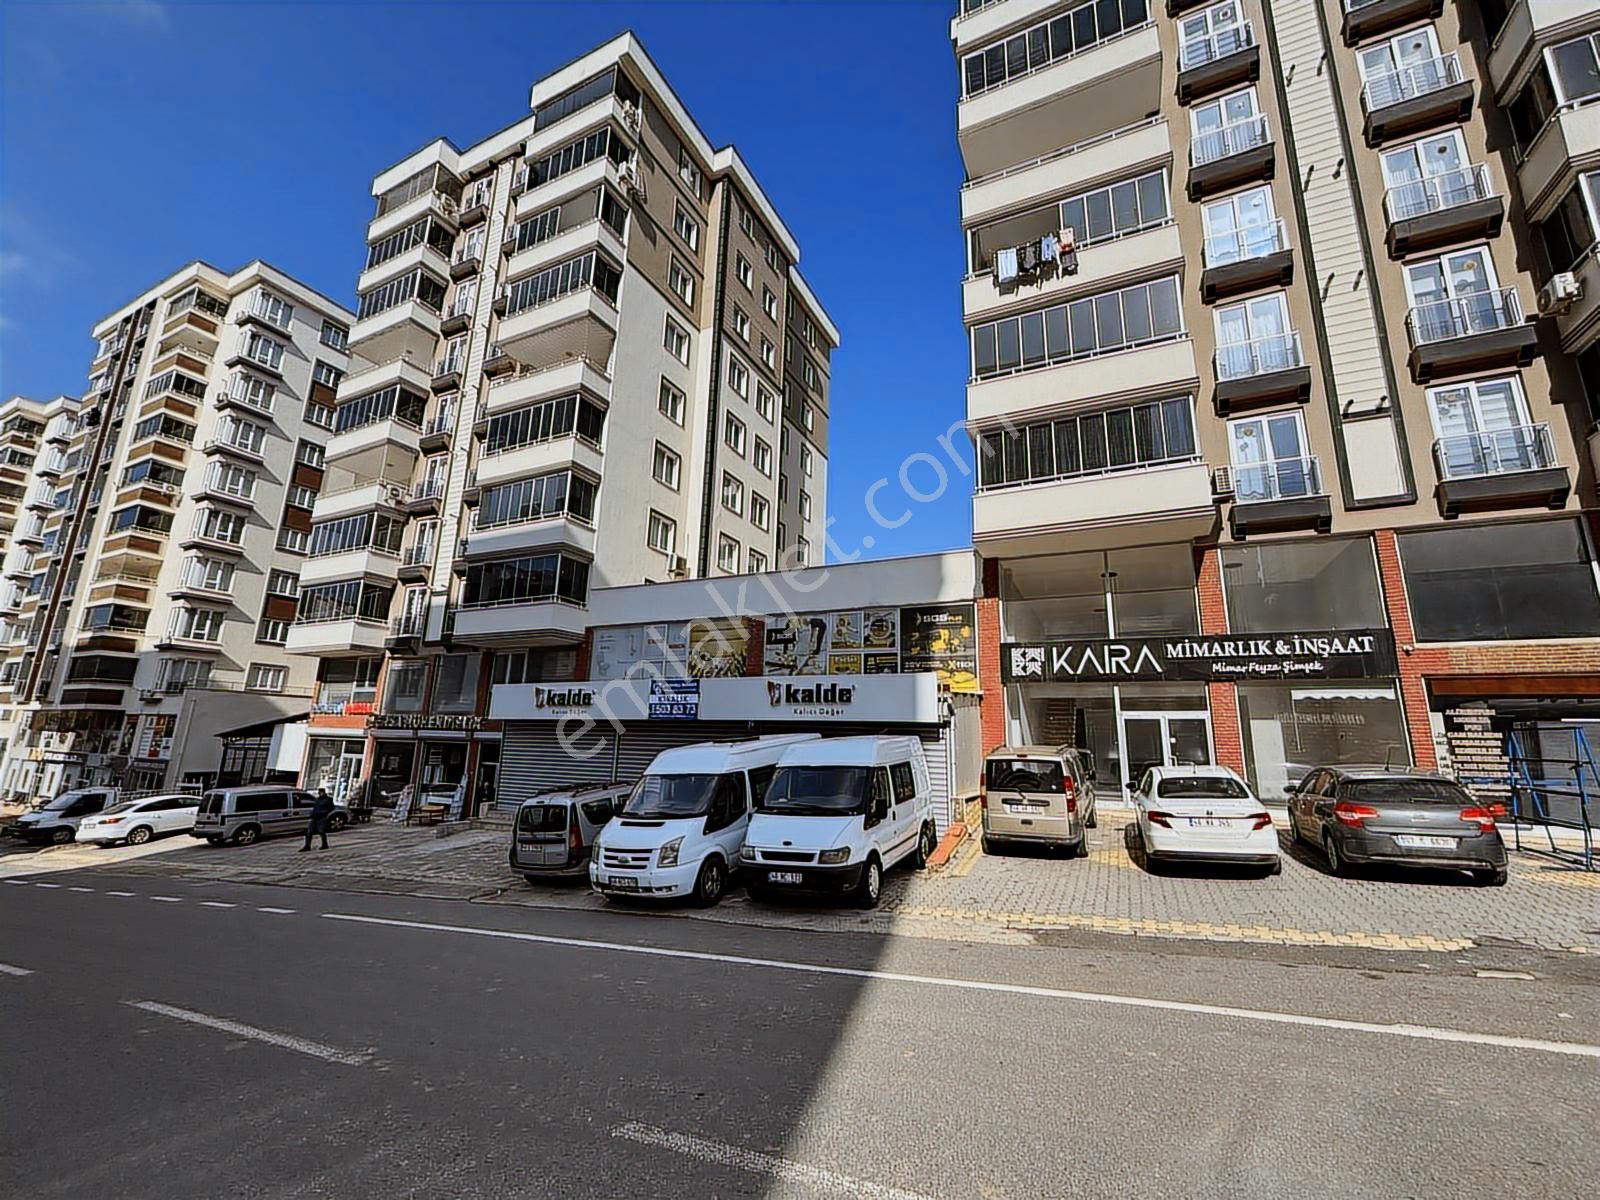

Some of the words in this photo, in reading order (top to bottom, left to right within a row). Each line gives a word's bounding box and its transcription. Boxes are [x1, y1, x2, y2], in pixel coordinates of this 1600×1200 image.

[1165, 639, 1271, 658] MİMARLIK
[1275, 640, 1291, 655] &
[1292, 635, 1374, 658] İNŞAAT
[1212, 662, 1247, 673] Mimar
[1249, 662, 1281, 674] Feyza
[1282, 661, 1324, 674] Şimşek
[785, 682, 852, 704] kalde
